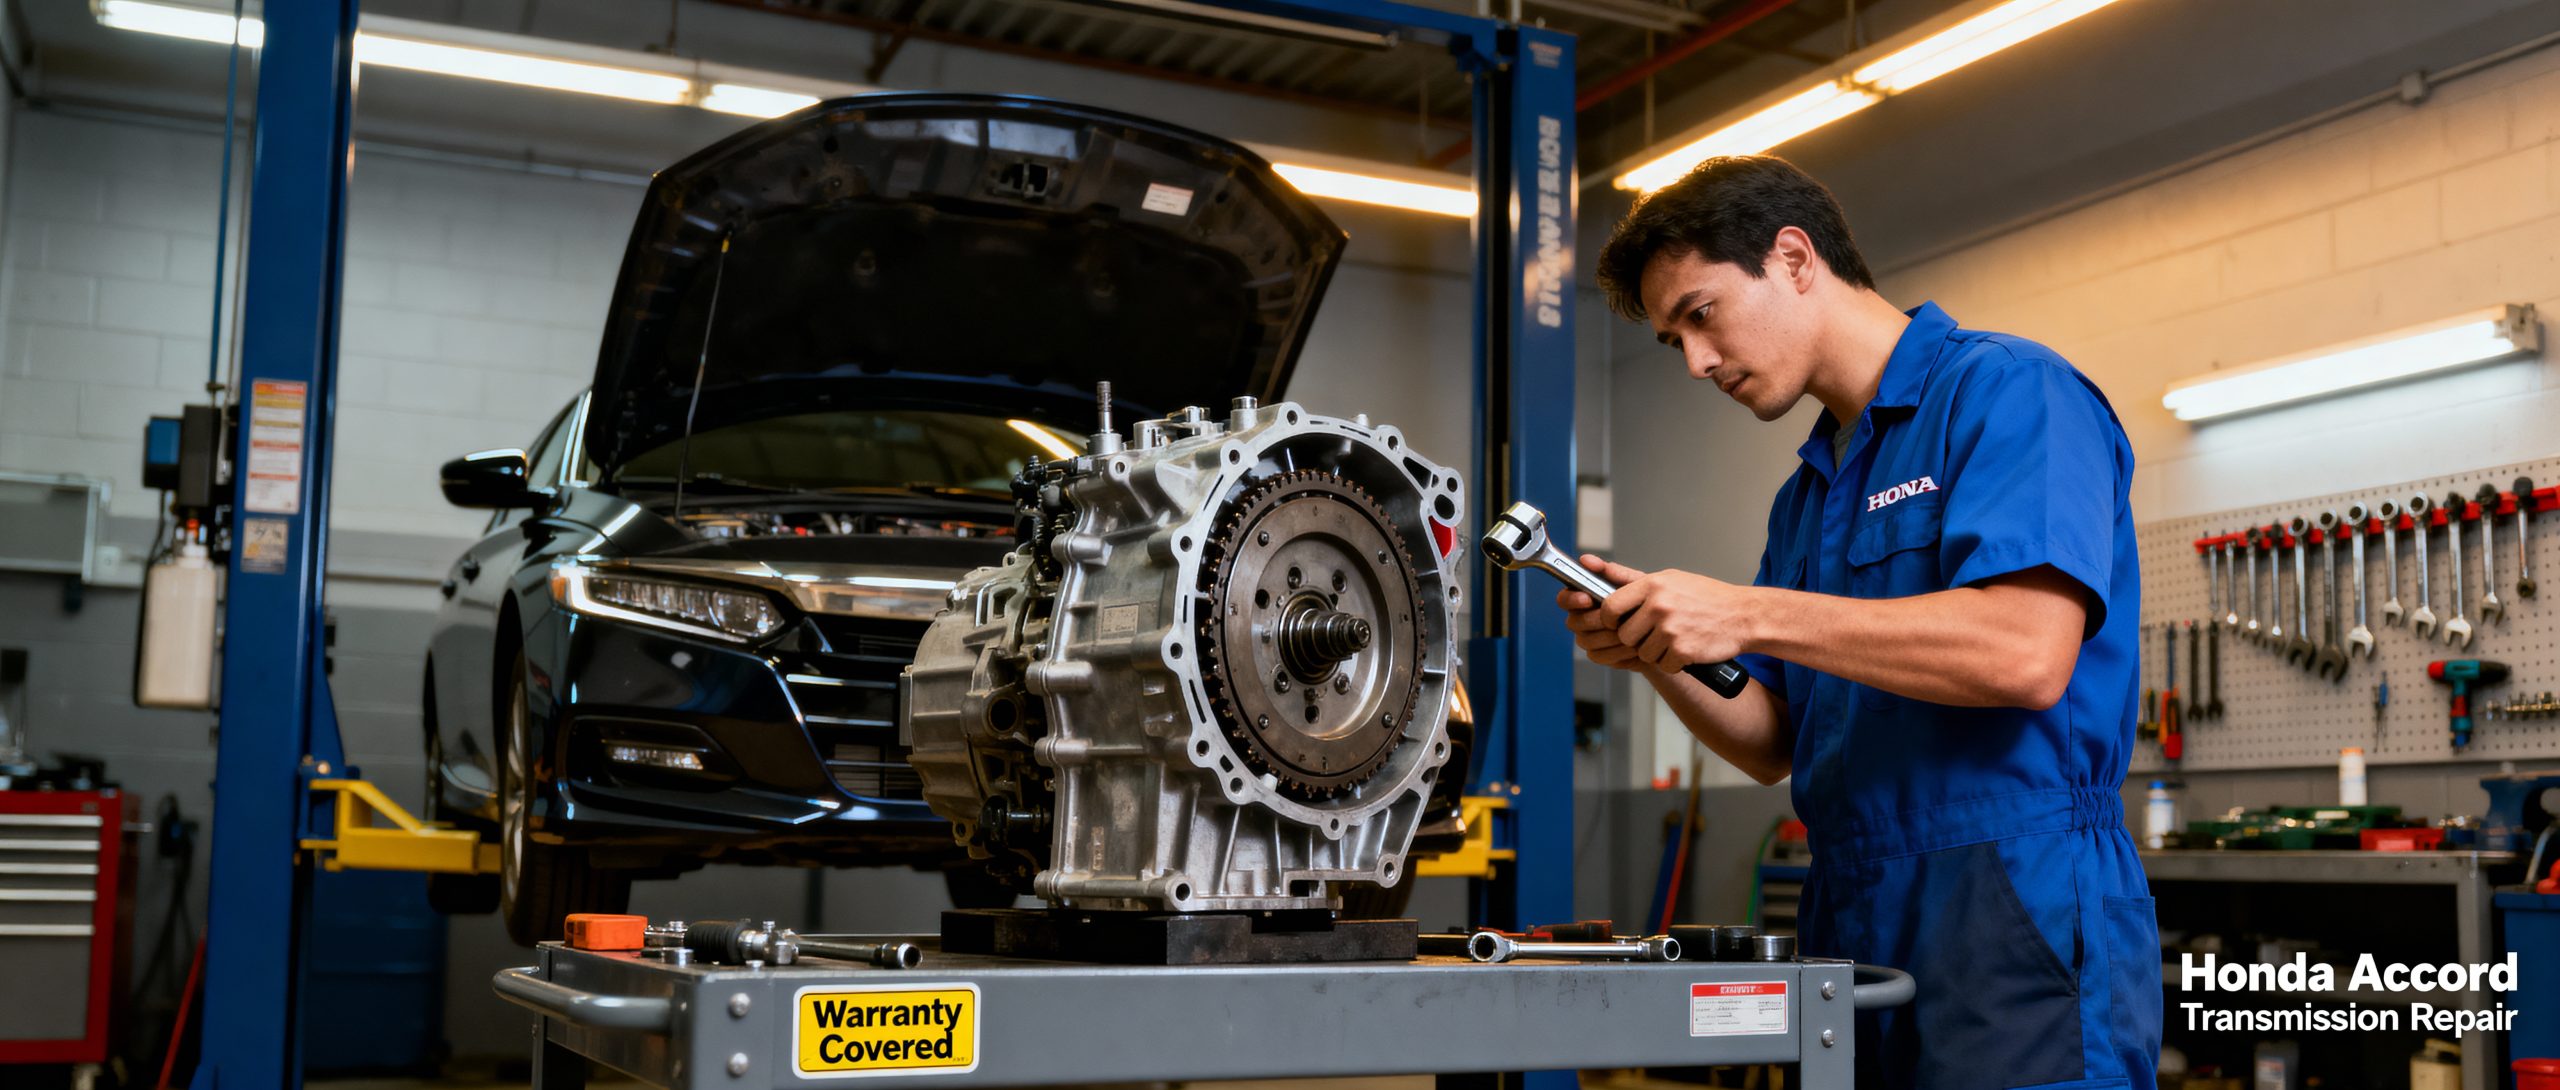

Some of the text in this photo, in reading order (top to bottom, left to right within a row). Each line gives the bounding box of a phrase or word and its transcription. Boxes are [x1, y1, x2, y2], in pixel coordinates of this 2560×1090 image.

[1867, 476, 1940, 512] HONA
[812, 998, 963, 1032] Warranty
[819, 1030, 953, 1064] Covered
